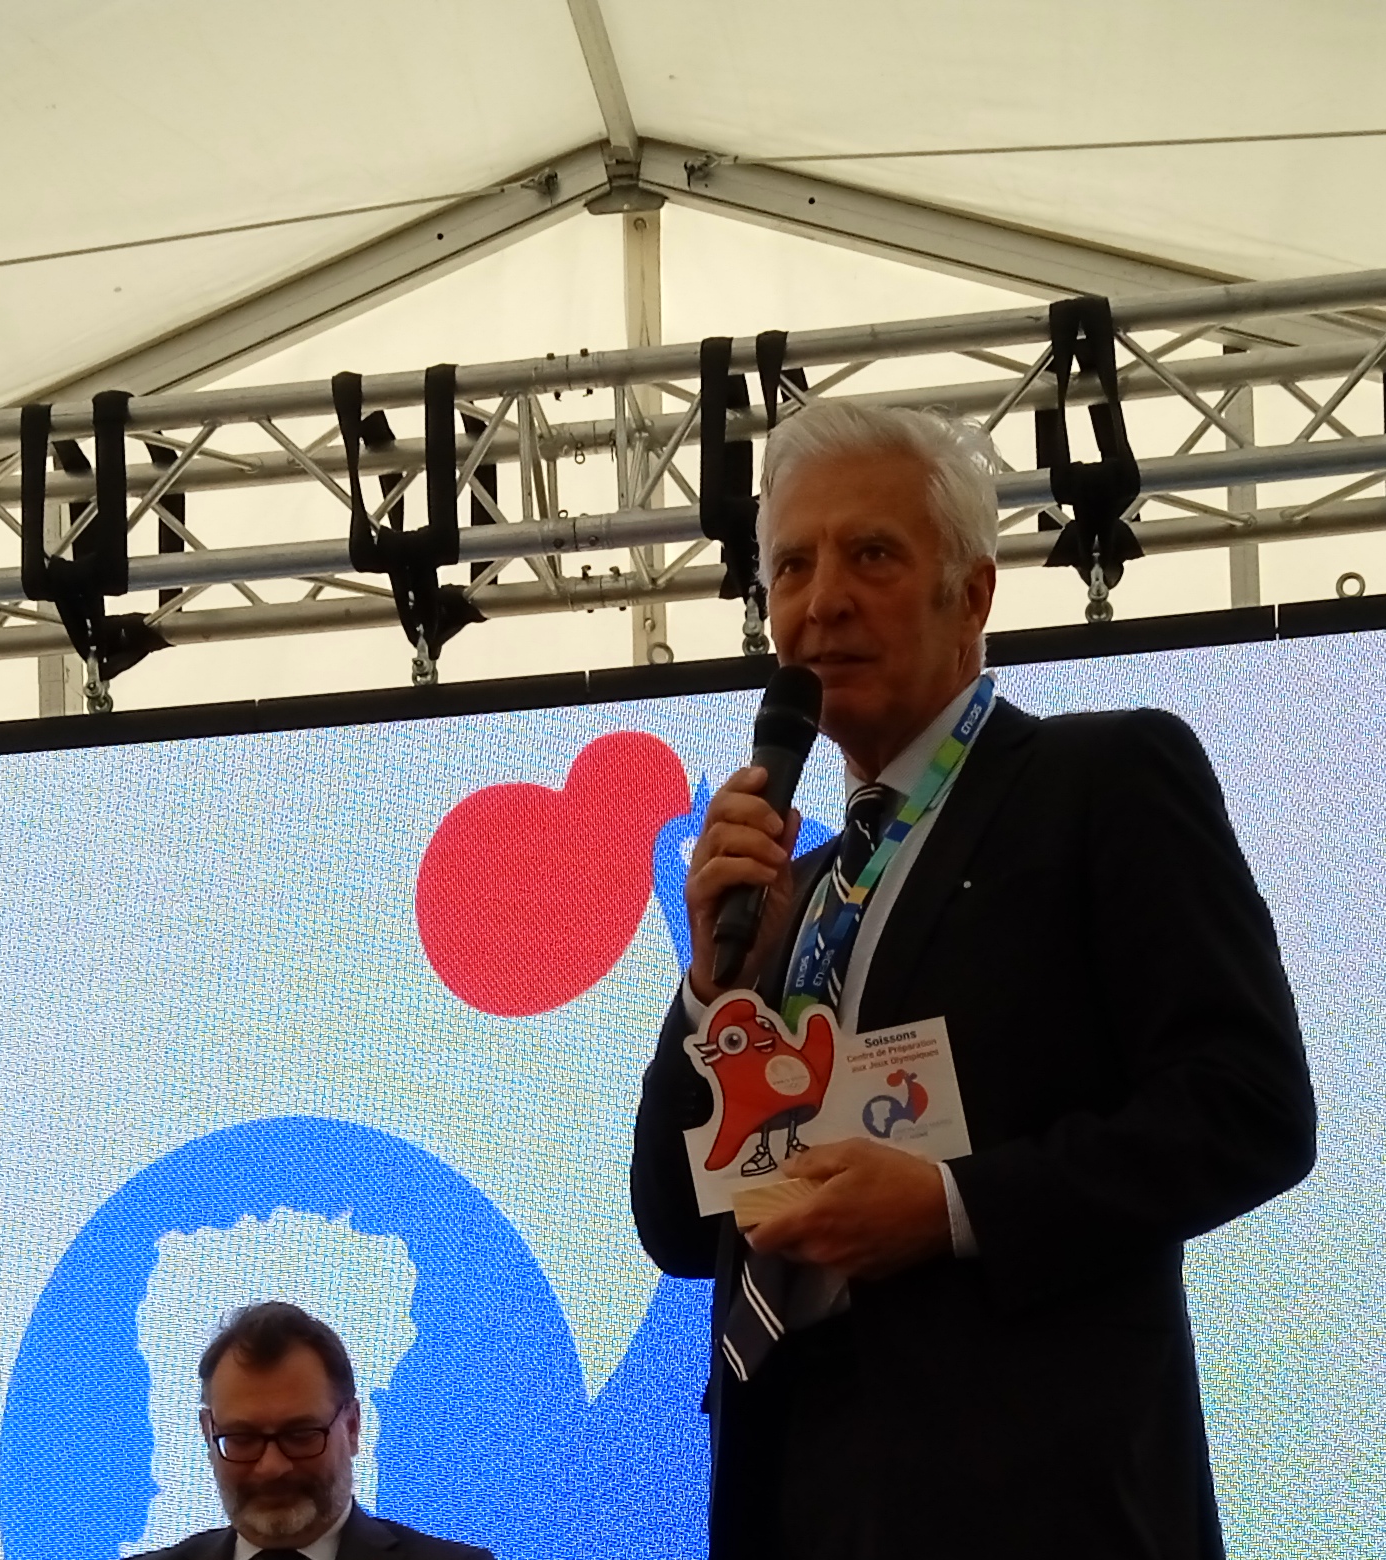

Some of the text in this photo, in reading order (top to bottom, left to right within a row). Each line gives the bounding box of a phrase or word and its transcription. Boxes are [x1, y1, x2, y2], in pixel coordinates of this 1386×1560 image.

[864, 1030, 917, 1049] Soissons
[846, 1038, 938, 1063] Centre de Préparation
[869, 1060, 889, 1070] Jeux
[890, 1049, 940, 1066] Olympiques
